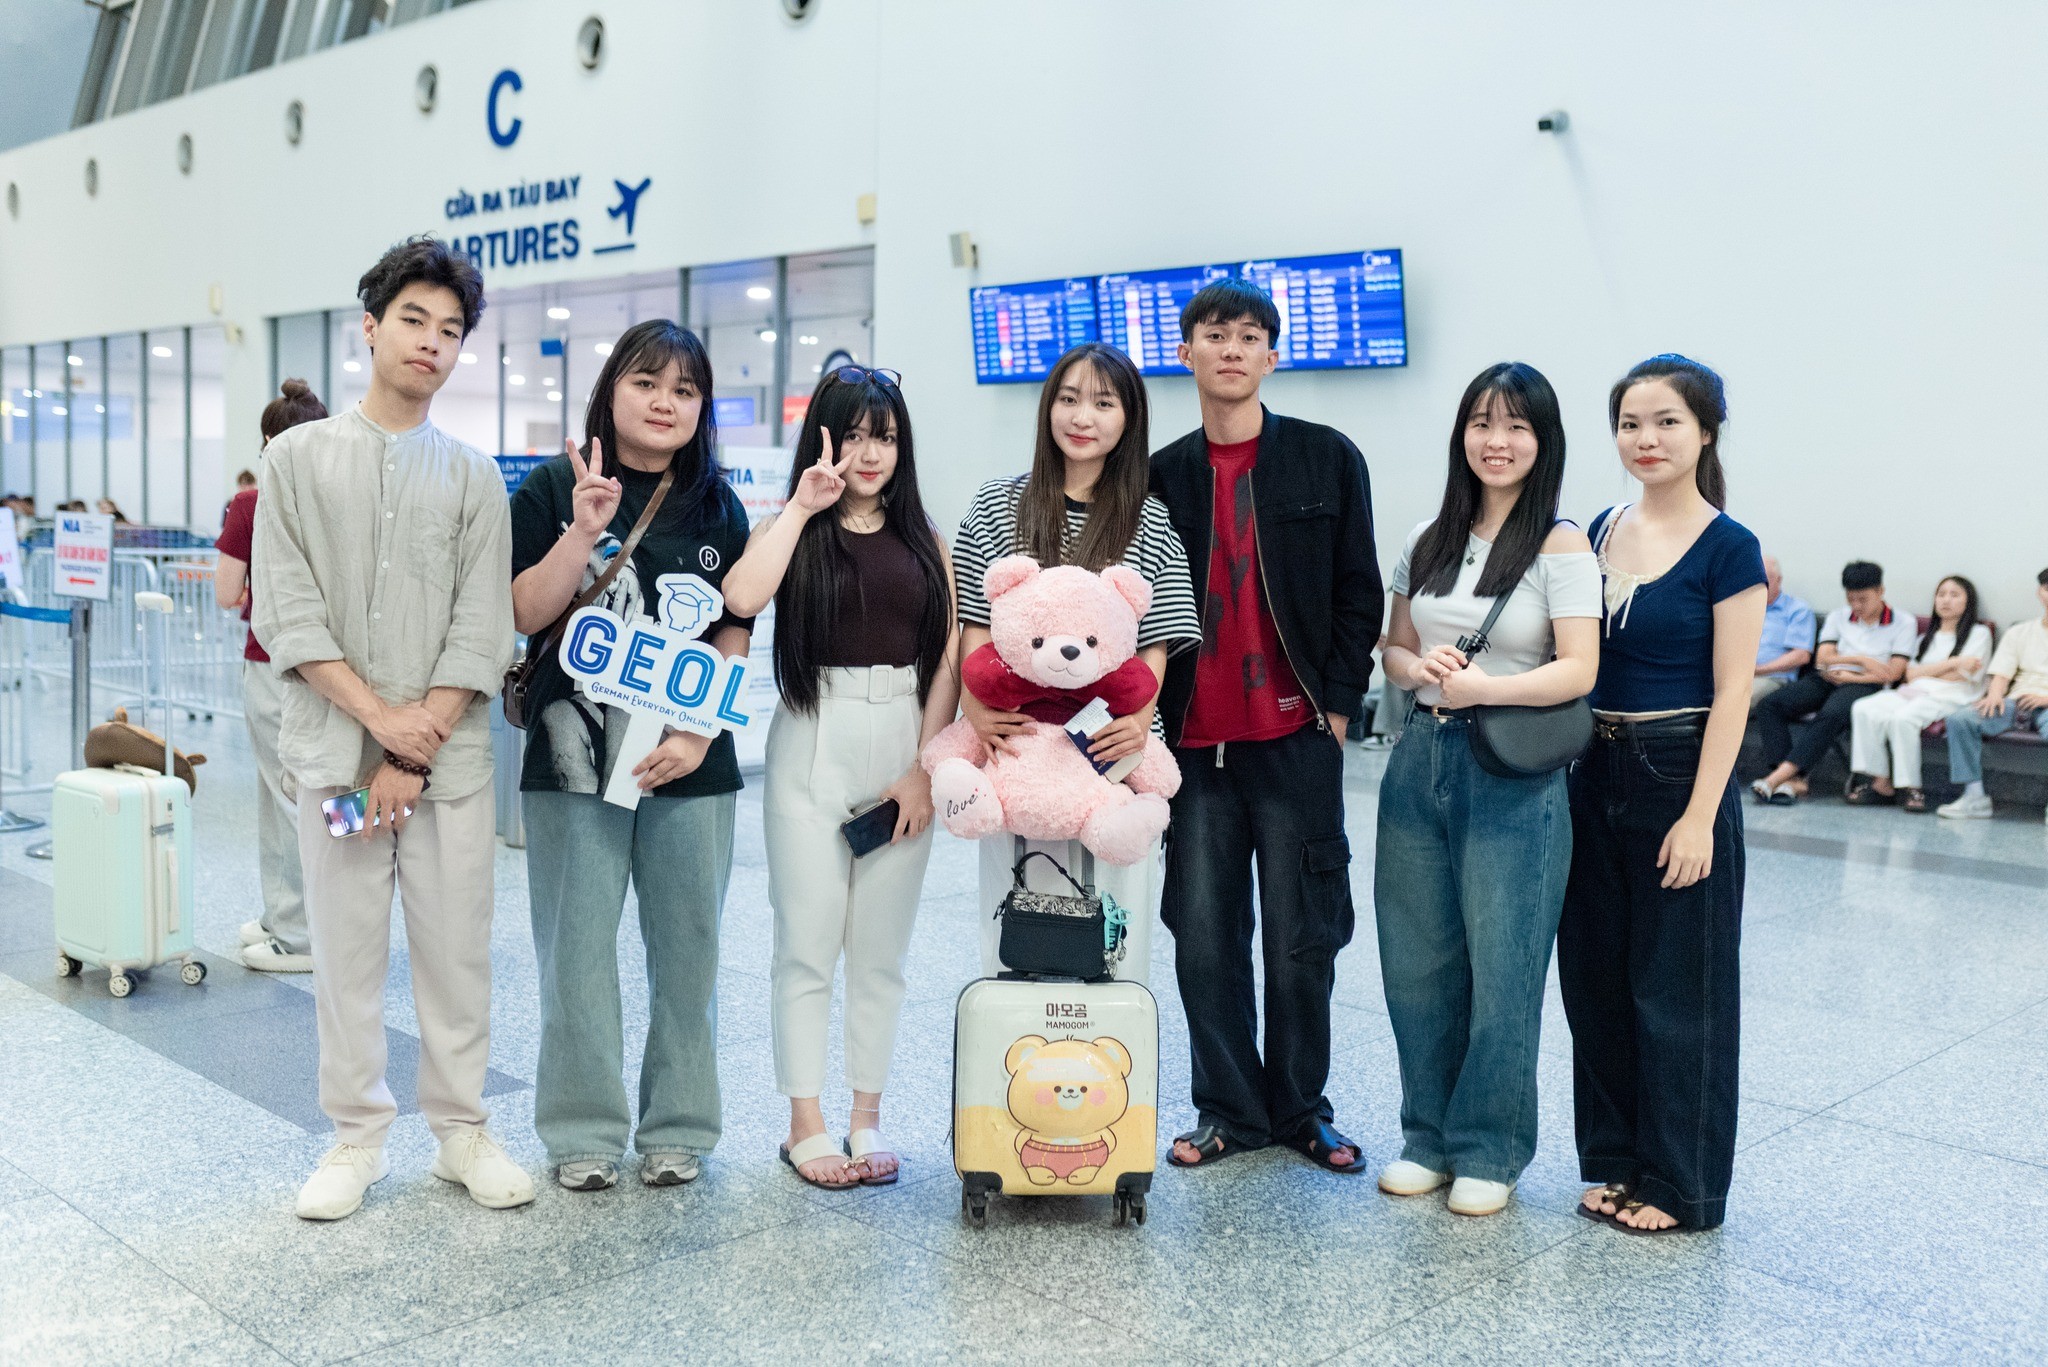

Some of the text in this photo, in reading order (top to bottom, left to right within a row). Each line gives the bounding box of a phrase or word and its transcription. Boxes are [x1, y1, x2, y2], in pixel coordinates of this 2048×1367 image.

[486, 69, 523, 148] C
[482, 191, 502, 212] RA
[545, 174, 580, 201] BAY
[452, 218, 580, 271] RTURES
[567, 615, 750, 727] GEOL
[946, 794, 979, 818] love
